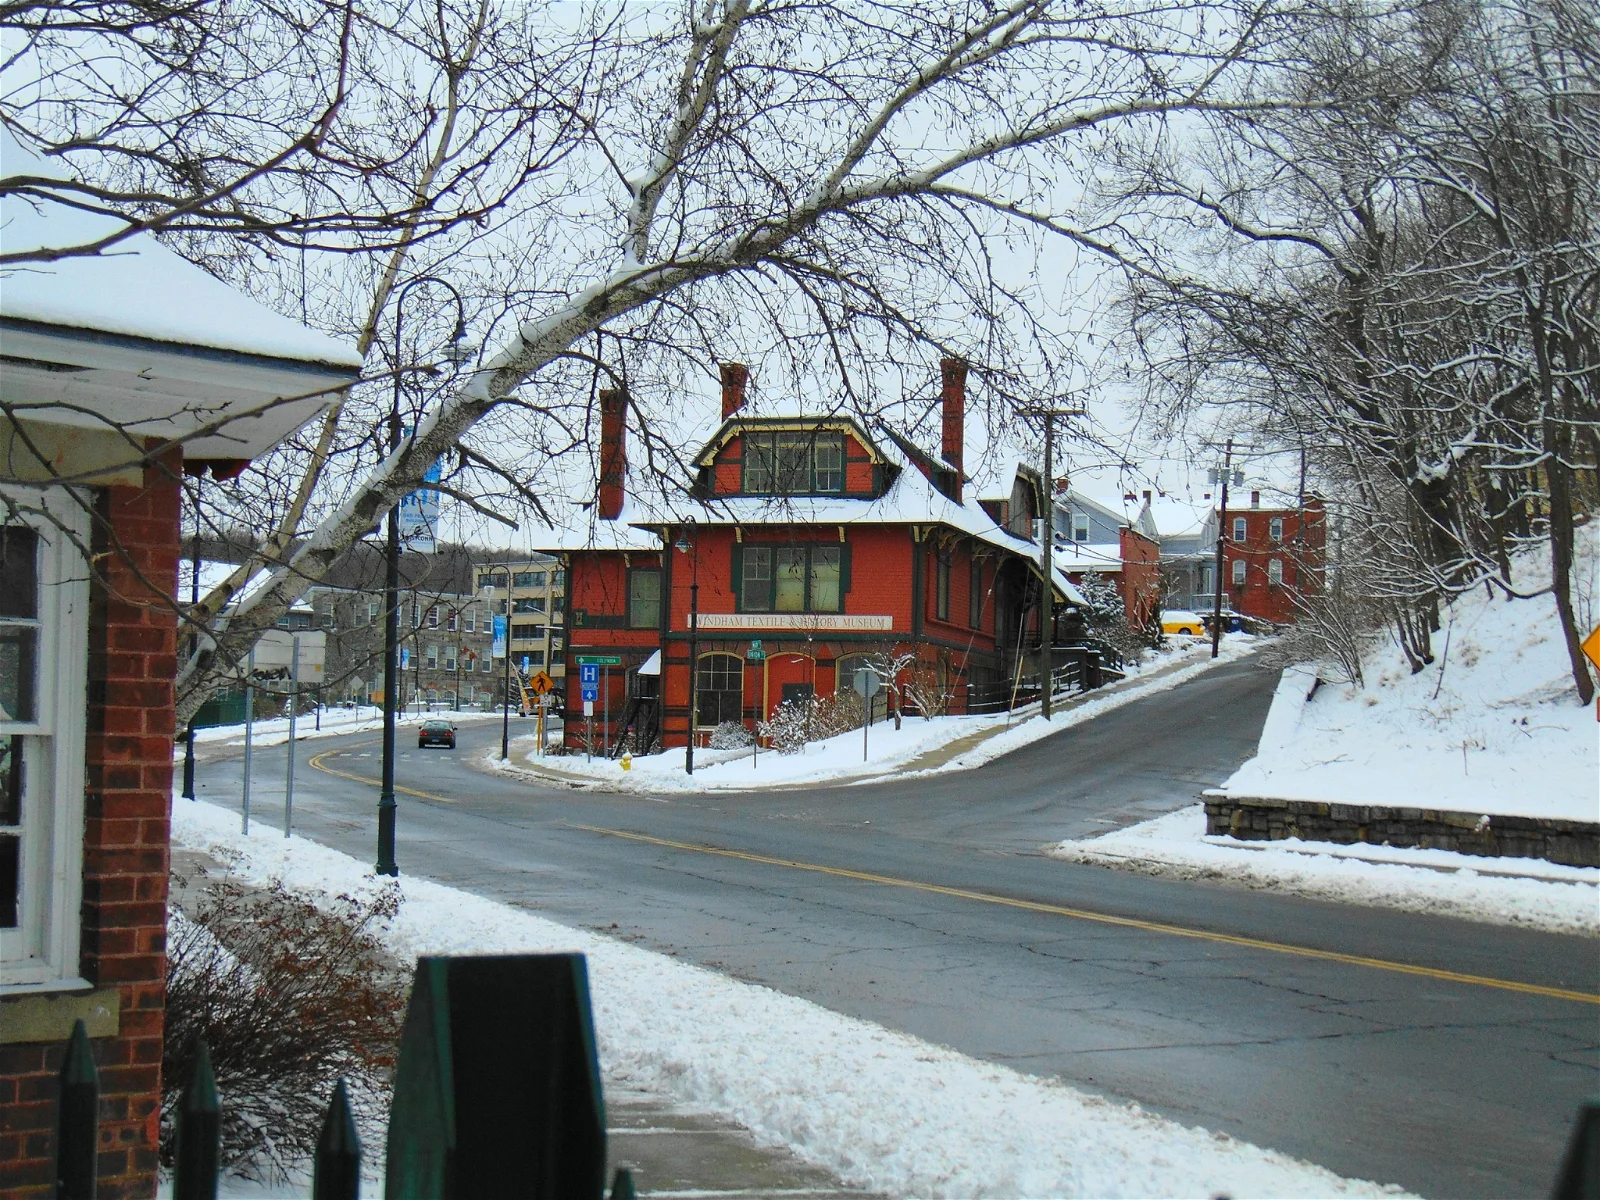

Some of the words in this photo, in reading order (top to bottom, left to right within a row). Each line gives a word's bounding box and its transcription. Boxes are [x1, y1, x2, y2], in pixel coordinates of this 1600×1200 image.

[746, 616, 785, 627] TEXTILE
[843, 617, 885, 628] MUSEUM
[584, 667, 595, 681] H
